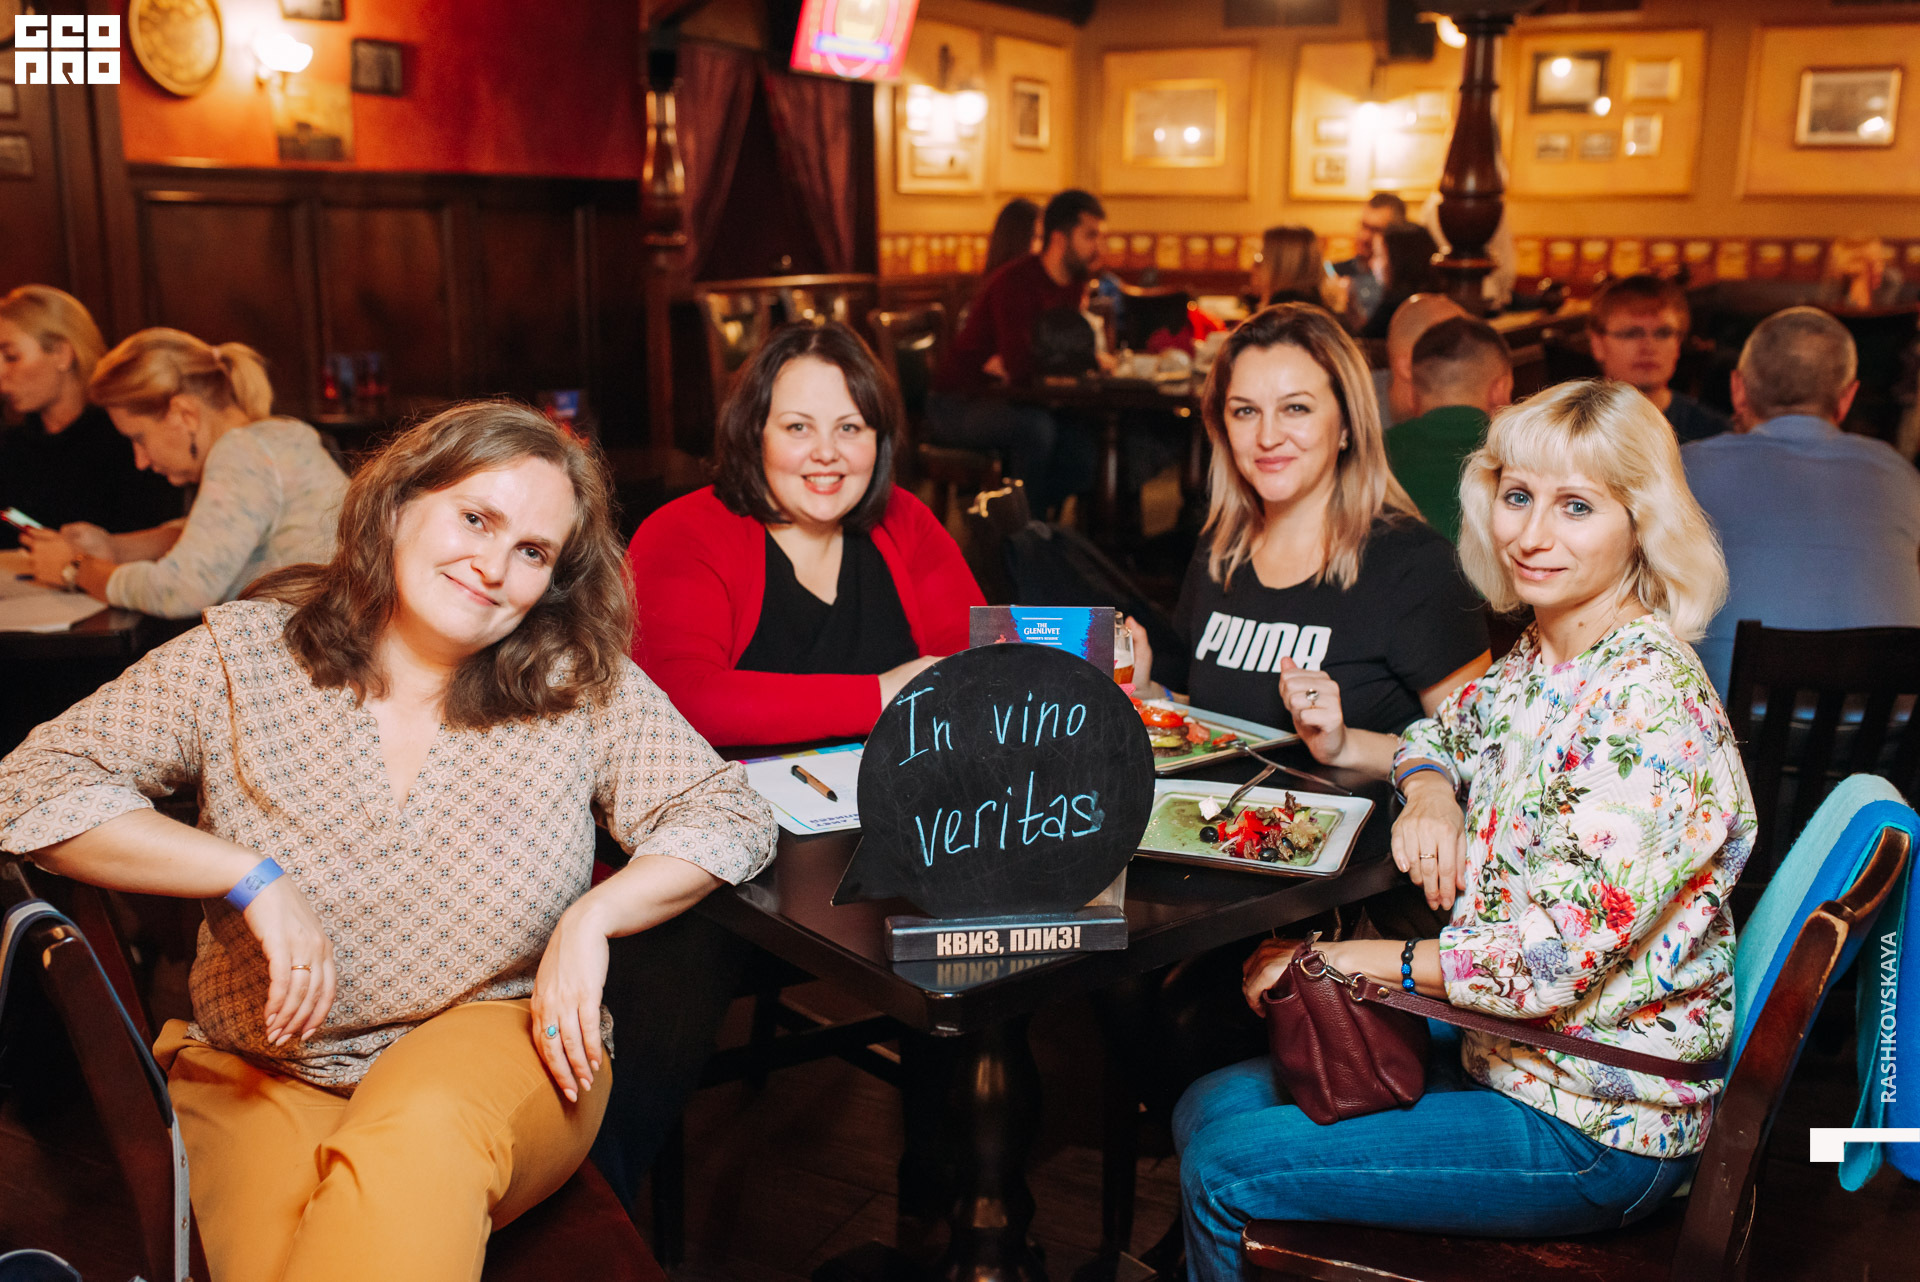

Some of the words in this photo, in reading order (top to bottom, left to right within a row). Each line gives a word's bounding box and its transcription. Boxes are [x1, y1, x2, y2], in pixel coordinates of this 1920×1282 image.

[1023, 627, 1061, 635] GLENLIVET
[1195, 611, 1332, 673] PUMA
[896, 686, 953, 766] In
[993, 690, 1087, 748] vino
[915, 770, 1105, 868] veritas
[936, 930, 1004, 956] КВИЗ,
[1009, 925, 1081, 953] ПЛИЗ!
